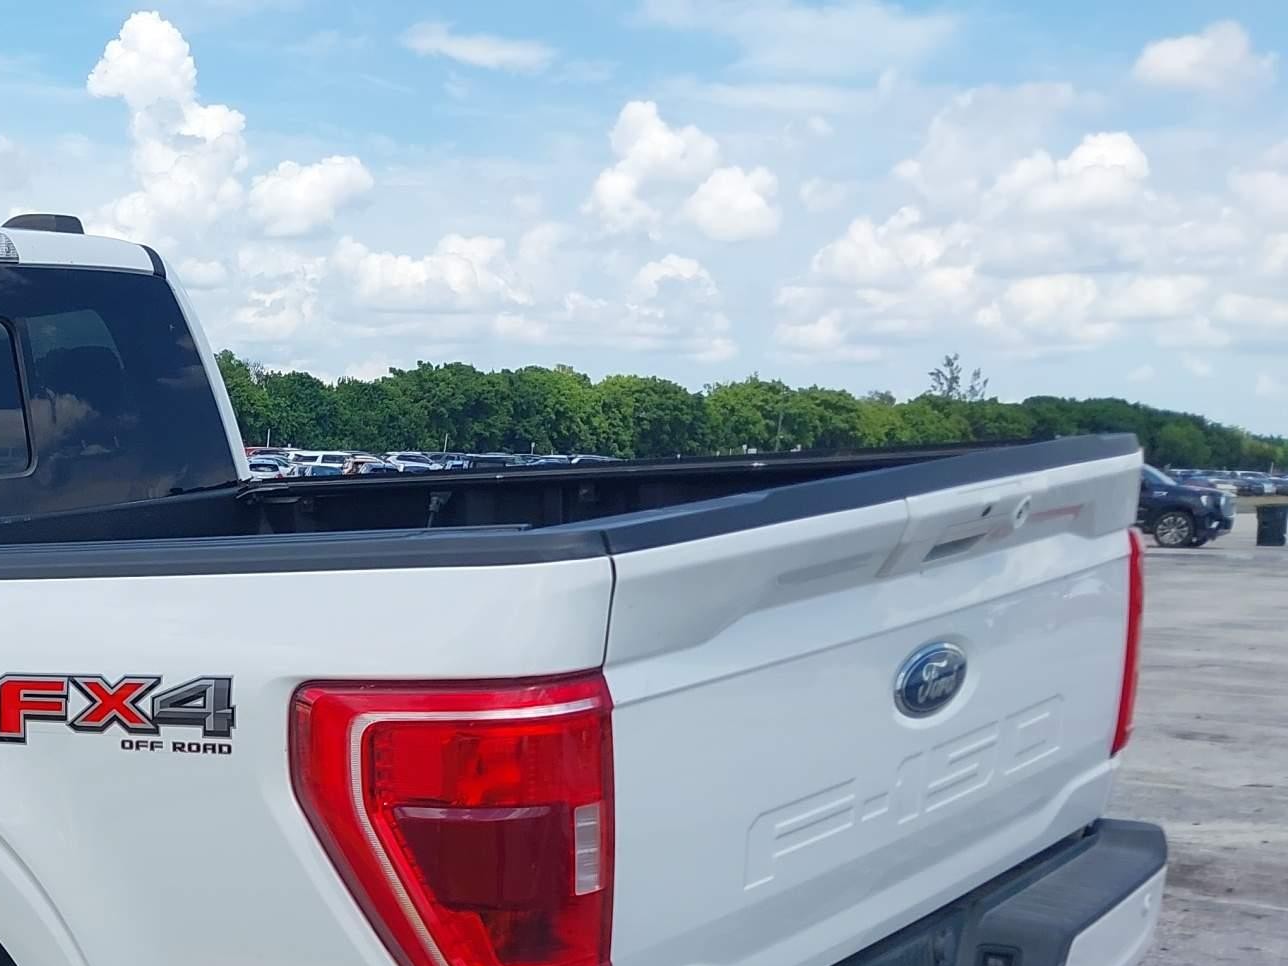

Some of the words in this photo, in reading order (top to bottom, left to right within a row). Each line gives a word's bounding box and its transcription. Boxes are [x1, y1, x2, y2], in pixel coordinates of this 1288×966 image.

[917, 660, 958, 704] Ford
[121, 740, 163, 751] OFF
[172, 742, 232, 755] ROAD
